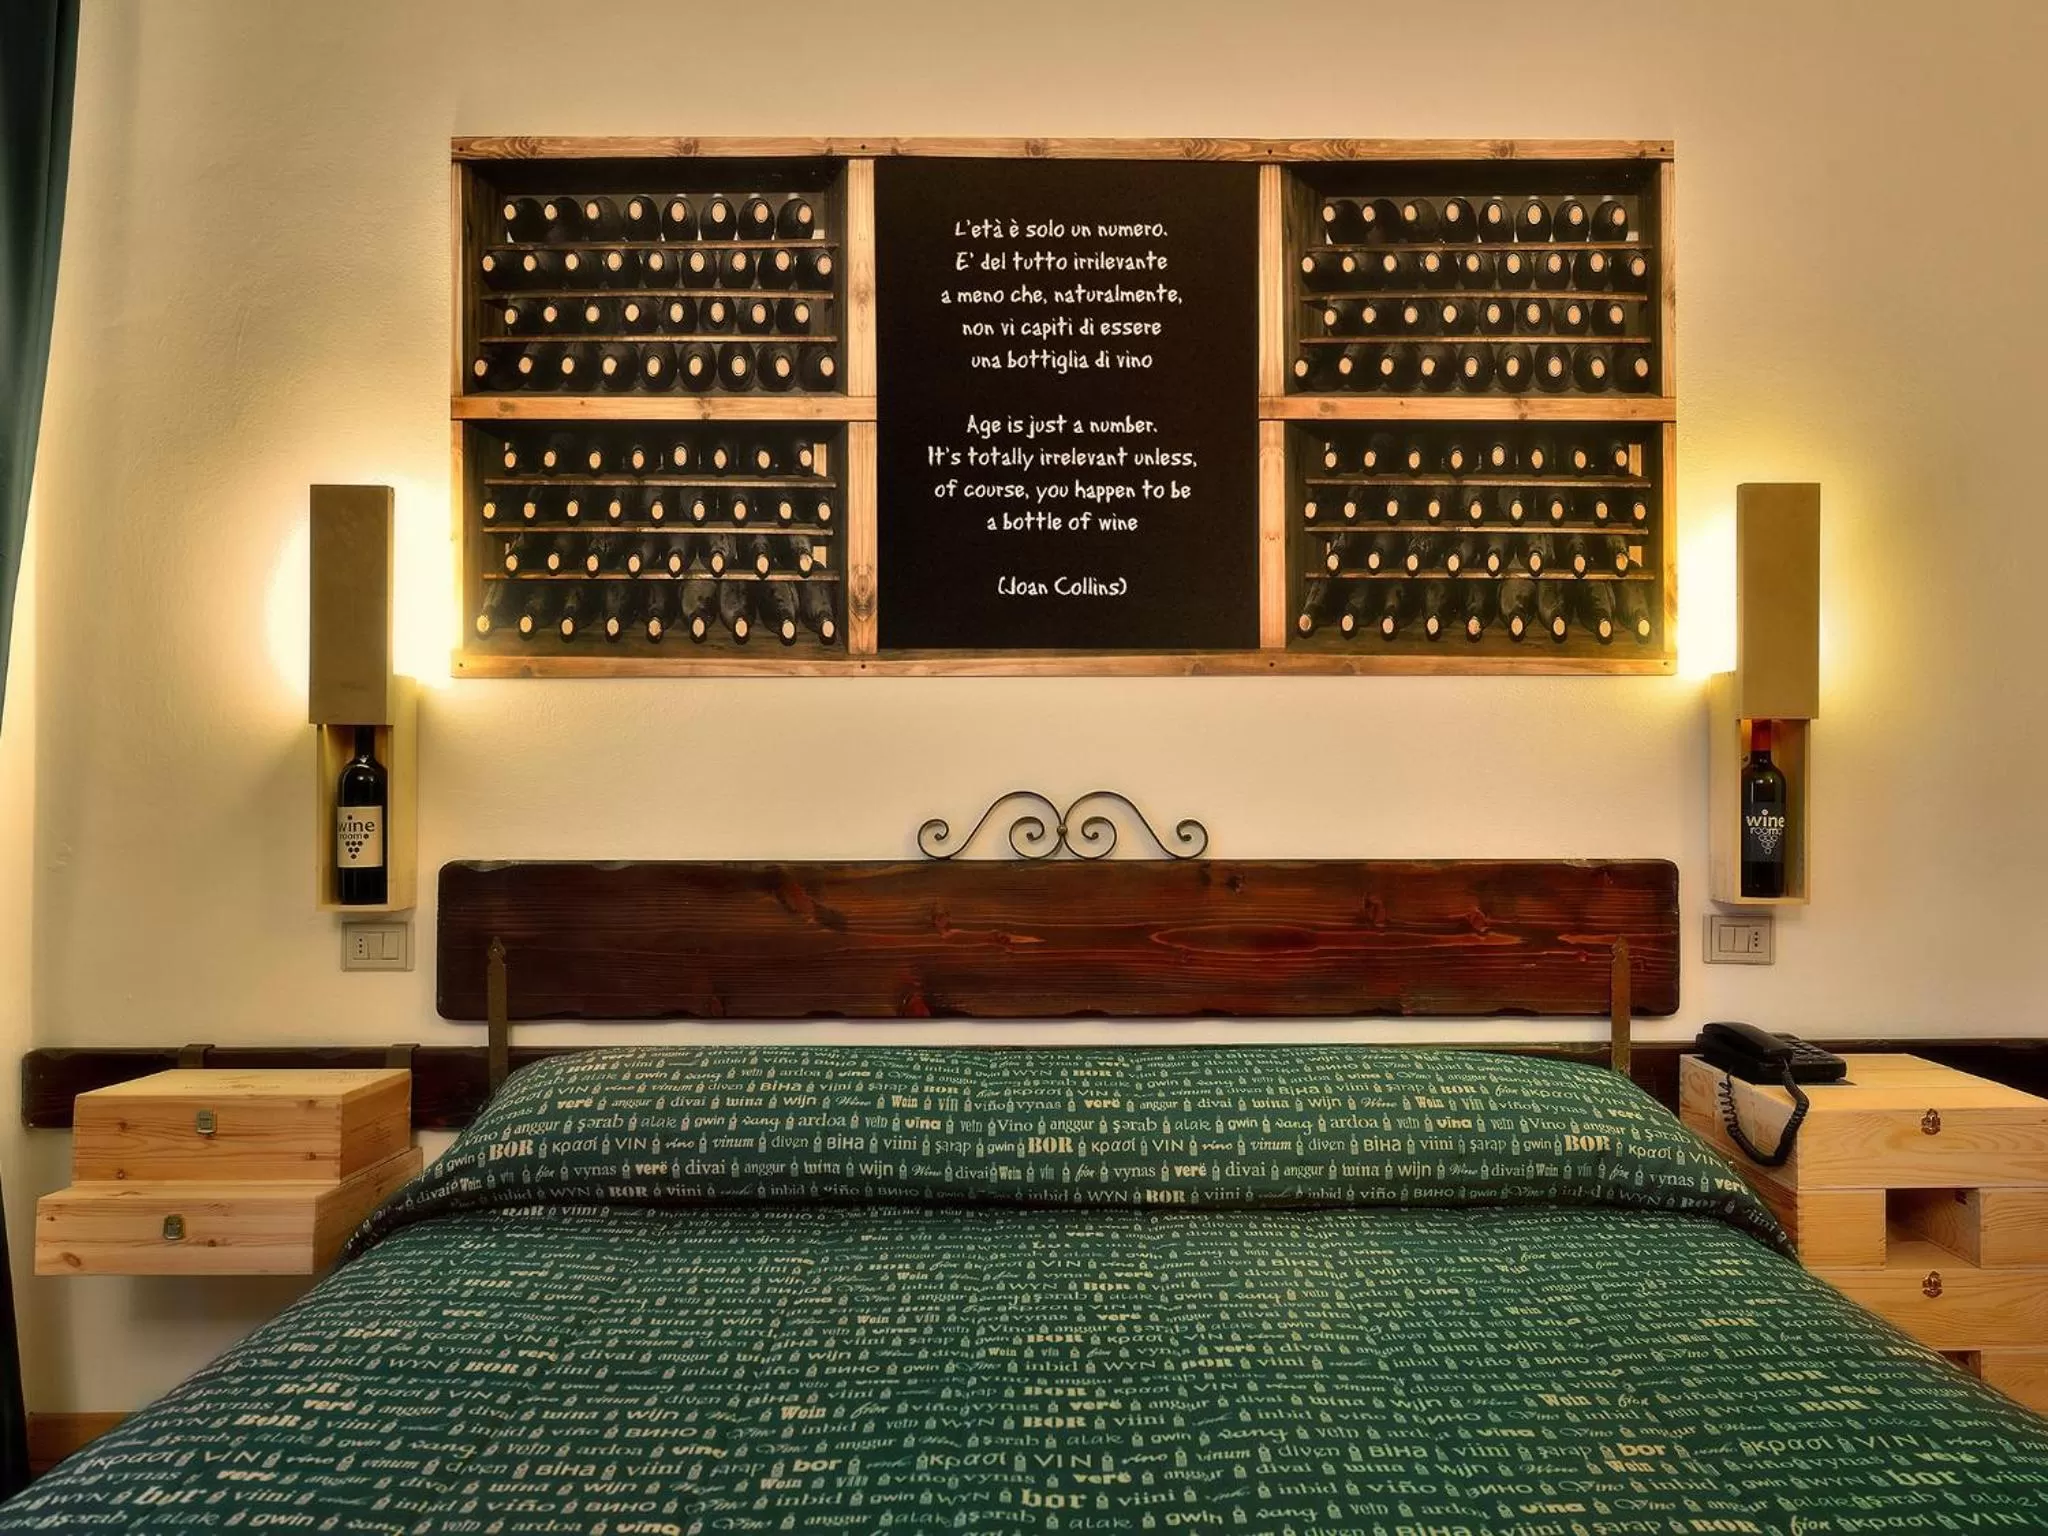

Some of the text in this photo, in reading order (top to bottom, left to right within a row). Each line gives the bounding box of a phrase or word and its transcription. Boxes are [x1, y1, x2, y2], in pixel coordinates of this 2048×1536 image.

[955, 219, 1168, 238] L'età è solo un numero.
[956, 251, 1167, 271] E' del tutto irrilevante
[941, 284, 1182, 304] a meno che, naturalmente,
[962, 316, 1161, 340] non vi capiti di essere
[971, 349, 1153, 374] una bottiglia di vino
[967, 414, 1157, 439] Age is just a number.
[928, 446, 1197, 471] It's totally irrelevant unless,
[934, 479, 1191, 504] of course, you happen to be
[987, 511, 1138, 531] a bottle of wine
[998, 576, 1127, 596] (Joan Collins)
[339, 814, 375, 832] wine
[1746, 809, 1785, 827] wine
[694, 1115, 725, 1128] gwin
[798, 1113, 847, 1126] ardoa
[1050, 1120, 1095, 1133] anggur
[1228, 1117, 1258, 1131] gwin
[1330, 1114, 1379, 1128] ardoa
[489, 1138, 533, 1161] BOR
[615, 1137, 647, 1150] VIN
[883, 1135, 917, 1150] viini
[987, 1141, 1015, 1154] gwin
[1028, 1137, 1073, 1153] BOR
[1152, 1139, 1183, 1152] VIN
[1419, 1140, 1453, 1150] viini
[1523, 1138, 1552, 1152] gwin
[1563, 1134, 1610, 1151] BOR
[573, 1165, 617, 1179] vynas
[685, 1159, 725, 1175] divai
[744, 1163, 786, 1176] anggur
[859, 1160, 893, 1179] wijn
[1113, 1167, 1156, 1182] vynas
[1225, 1161, 1266, 1177] divai
[1283, 1166, 1324, 1179] anggur
[1397, 1162, 1431, 1180] wijn
[549, 1186, 590, 1198] WYN
[609, 1186, 648, 1197] BOR
[666, 1184, 701, 1196] viini
[1087, 1190, 1127, 1202] WYN
[1146, 1189, 1185, 1203] BOR
[1204, 1187, 1240, 1200] viini
